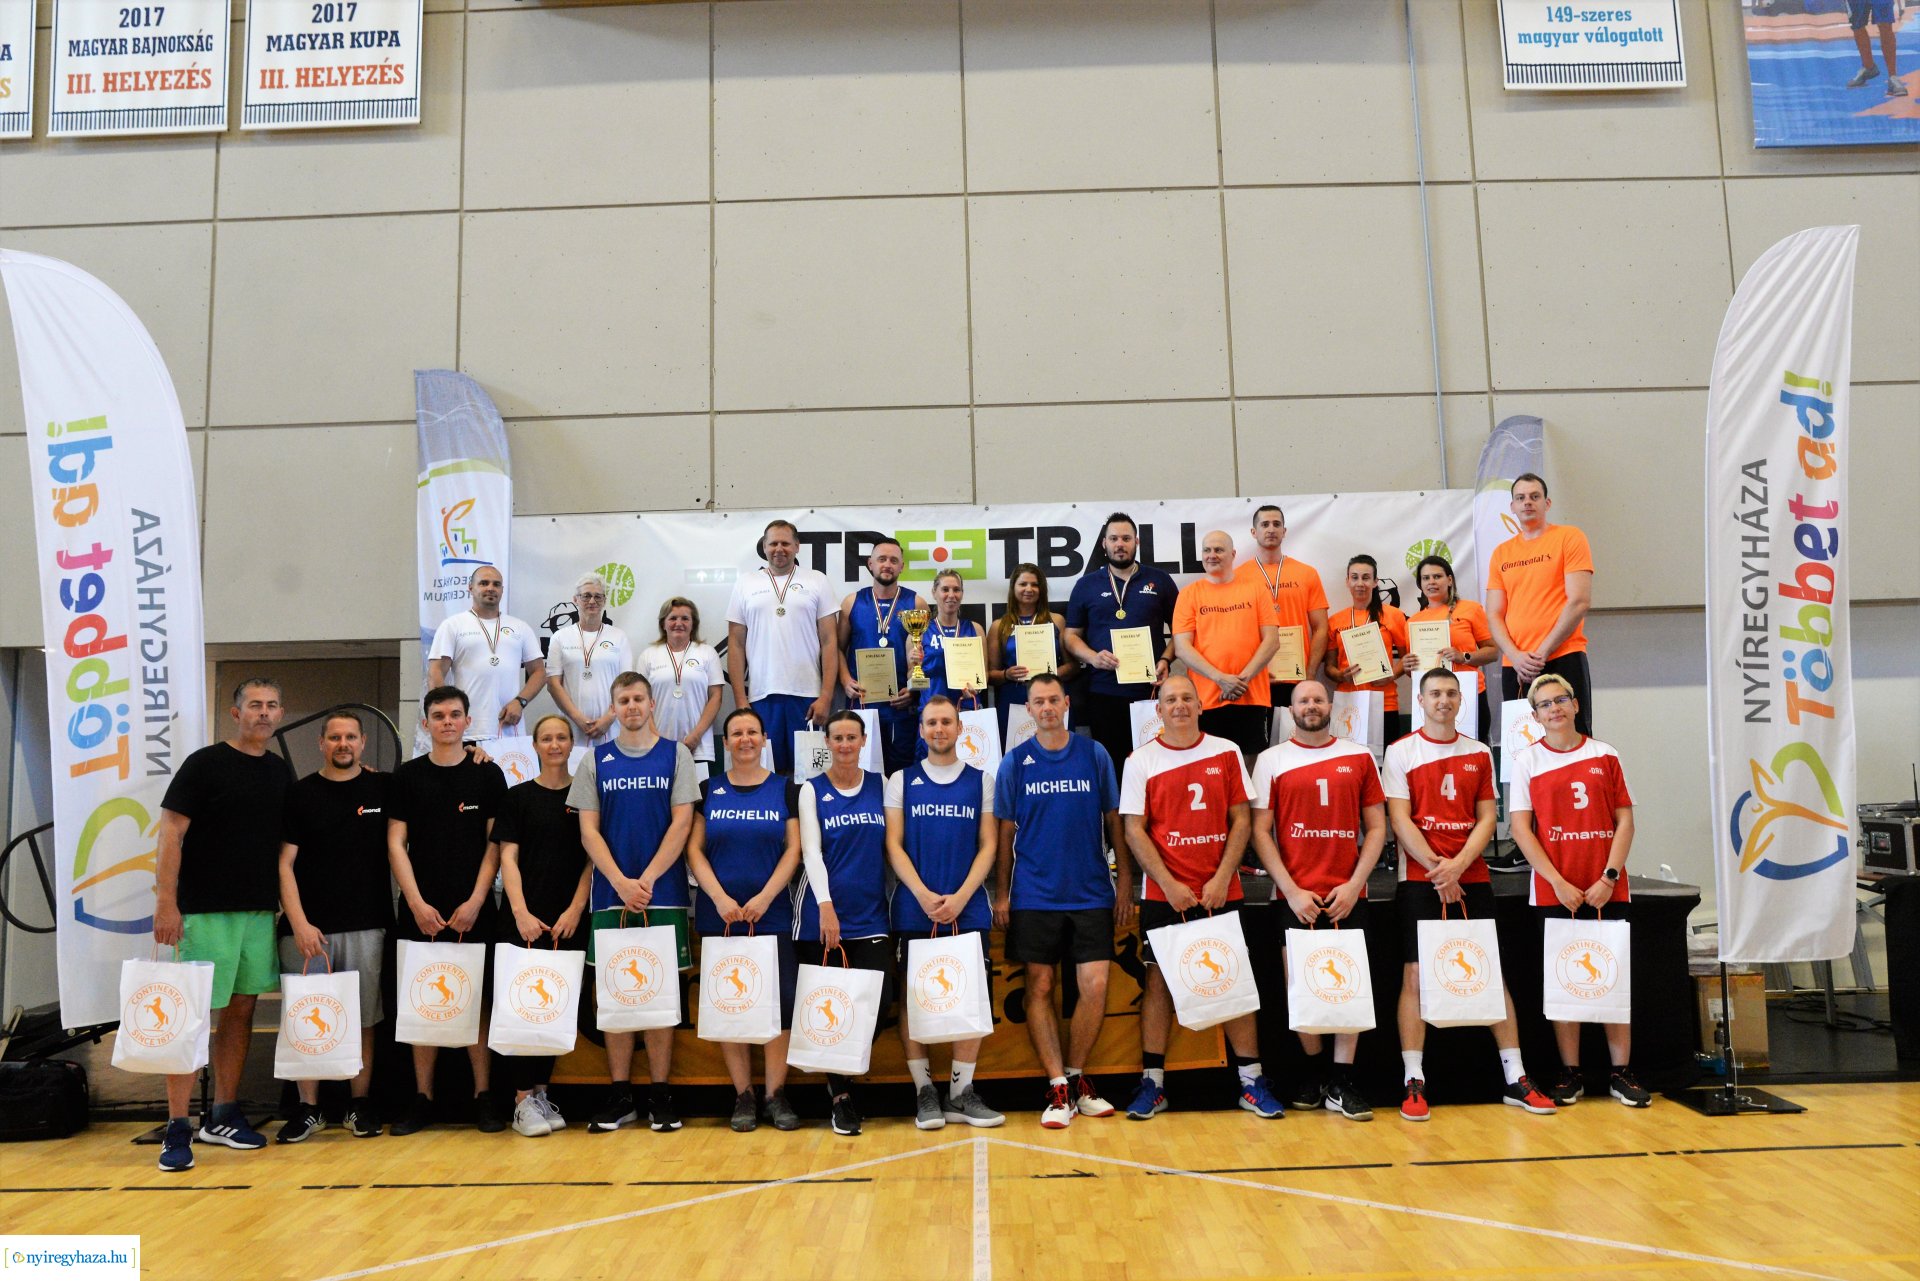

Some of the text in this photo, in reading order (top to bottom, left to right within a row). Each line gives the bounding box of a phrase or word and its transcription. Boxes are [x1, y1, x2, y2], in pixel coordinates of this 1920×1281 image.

[118, 7, 166, 28] 2017
[311, 2, 359, 24] 2017
[1545, 6, 1633, 23] 149-szeres
[67, 29, 214, 57] MAGYAR BAJNOKSÁG
[265, 30, 401, 52] MAGYAR KUPA
[1517, 25, 1664, 49] magyar válogatott
[66, 63, 212, 95] III. HELYEZÉS
[259, 58, 405, 89] III. HELYEZÉS
[1778, 370, 1840, 727] Többet ad!
[1501, 554, 1544, 572] Continental
[1734, 458, 1772, 723] NYÍREGYHÁZA
[1199, 602, 1245, 616] Continental
[602, 776, 670, 793] MICHELIN
[1025, 779, 1091, 796] MICHELIN
[1315, 778, 1329, 806] 1
[1440, 774, 1456, 800] 4
[1187, 783, 1207, 811] 2
[1570, 781, 1589, 810] 3
[709, 808, 780, 821] MICHELIN
[824, 812, 886, 831] MICHELIN
[911, 803, 975, 820] MICHELIN
[1304, 828, 1355, 839] marso
[1436, 822, 1475, 830] mars
[1564, 829, 1614, 840] marso
[1181, 833, 1227, 846] marso
[608, 948, 660, 970] CONTINENTAL
[1182, 938, 1231, 965] CONTINENTAL
[1307, 948, 1355, 968] CONTINENTAL
[1436, 940, 1485, 960] CONTINENTAL
[1561, 941, 1614, 962] CONTINENTAL
[416, 963, 467, 985] CONTINENTAL
[712, 957, 759, 977] CONTINENTAL
[918, 957, 964, 979] CONTINENTAL
[515, 967, 566, 990] CONTINENTAL
[1192, 978, 1234, 996] SINCE 1871
[1444, 981, 1485, 995] SINCE 1871
[131, 982, 184, 1009] CONTINENTAL
[612, 990, 656, 1006] SINCE 1871
[805, 987, 850, 1010] CONTINENTAL
[1315, 989, 1355, 1003] SINCE 1871
[1565, 982, 1610, 998] SINCE 1871
[288, 995, 343, 1018] CONTINENTAL
[417, 1004, 462, 1020] SINCE 1871
[714, 999, 754, 1014] SINCE 1871
[922, 996, 960, 1012] SINCE 1871
[516, 1006, 560, 1023] SINCE 1871
[131, 1028, 175, 1047] SINCE 1871
[293, 1038, 339, 1055] SINCE 1871
[805, 1028, 845, 1045] SINCE 1871
